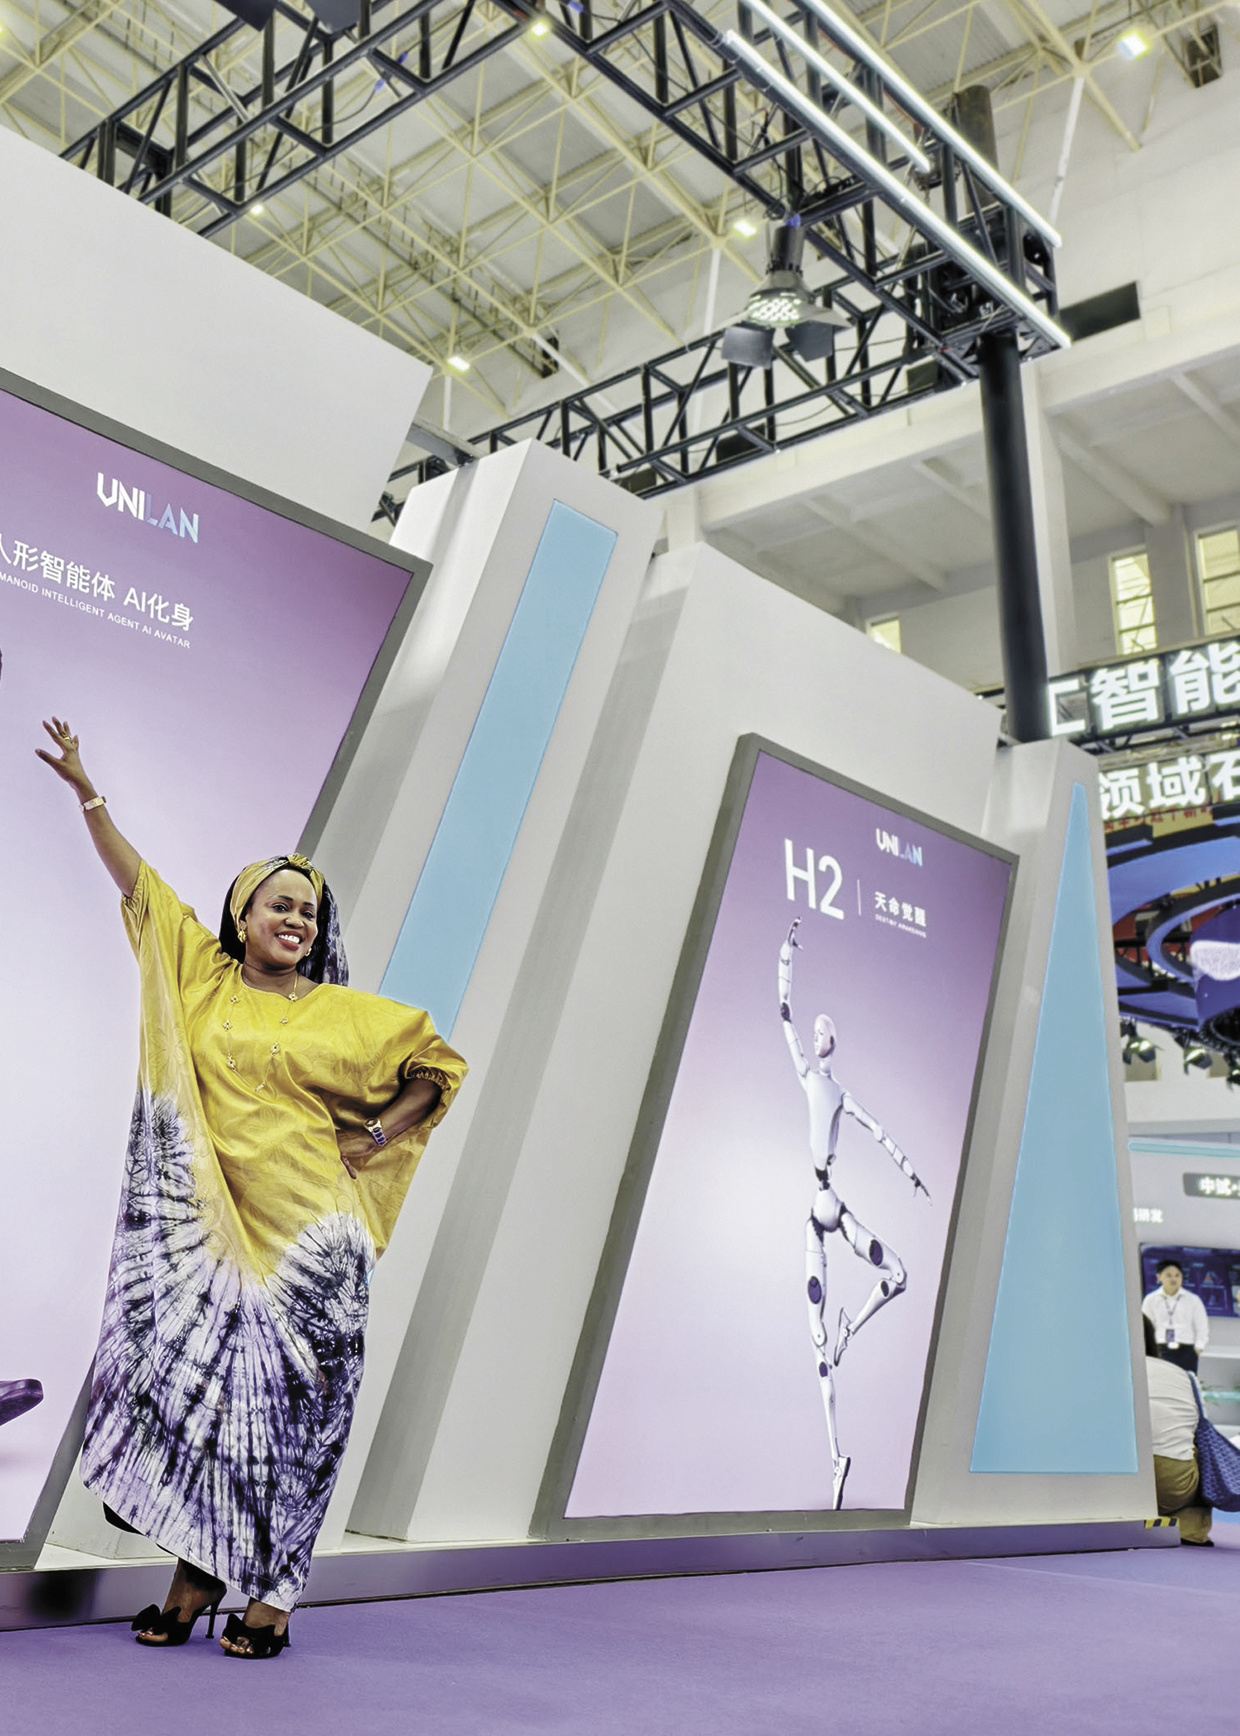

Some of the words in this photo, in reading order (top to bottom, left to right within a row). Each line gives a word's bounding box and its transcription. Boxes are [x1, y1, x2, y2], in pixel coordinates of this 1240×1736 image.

[96, 471, 200, 544] UNILAN
[41, 587, 105, 618] INTELLIGENT
[108, 612, 140, 631] AGENT
[142, 625, 152, 635] AI
[154, 629, 191, 649] AVATAR
[123, 587, 194, 631] AI化身
[784, 838, 845, 921] H2
